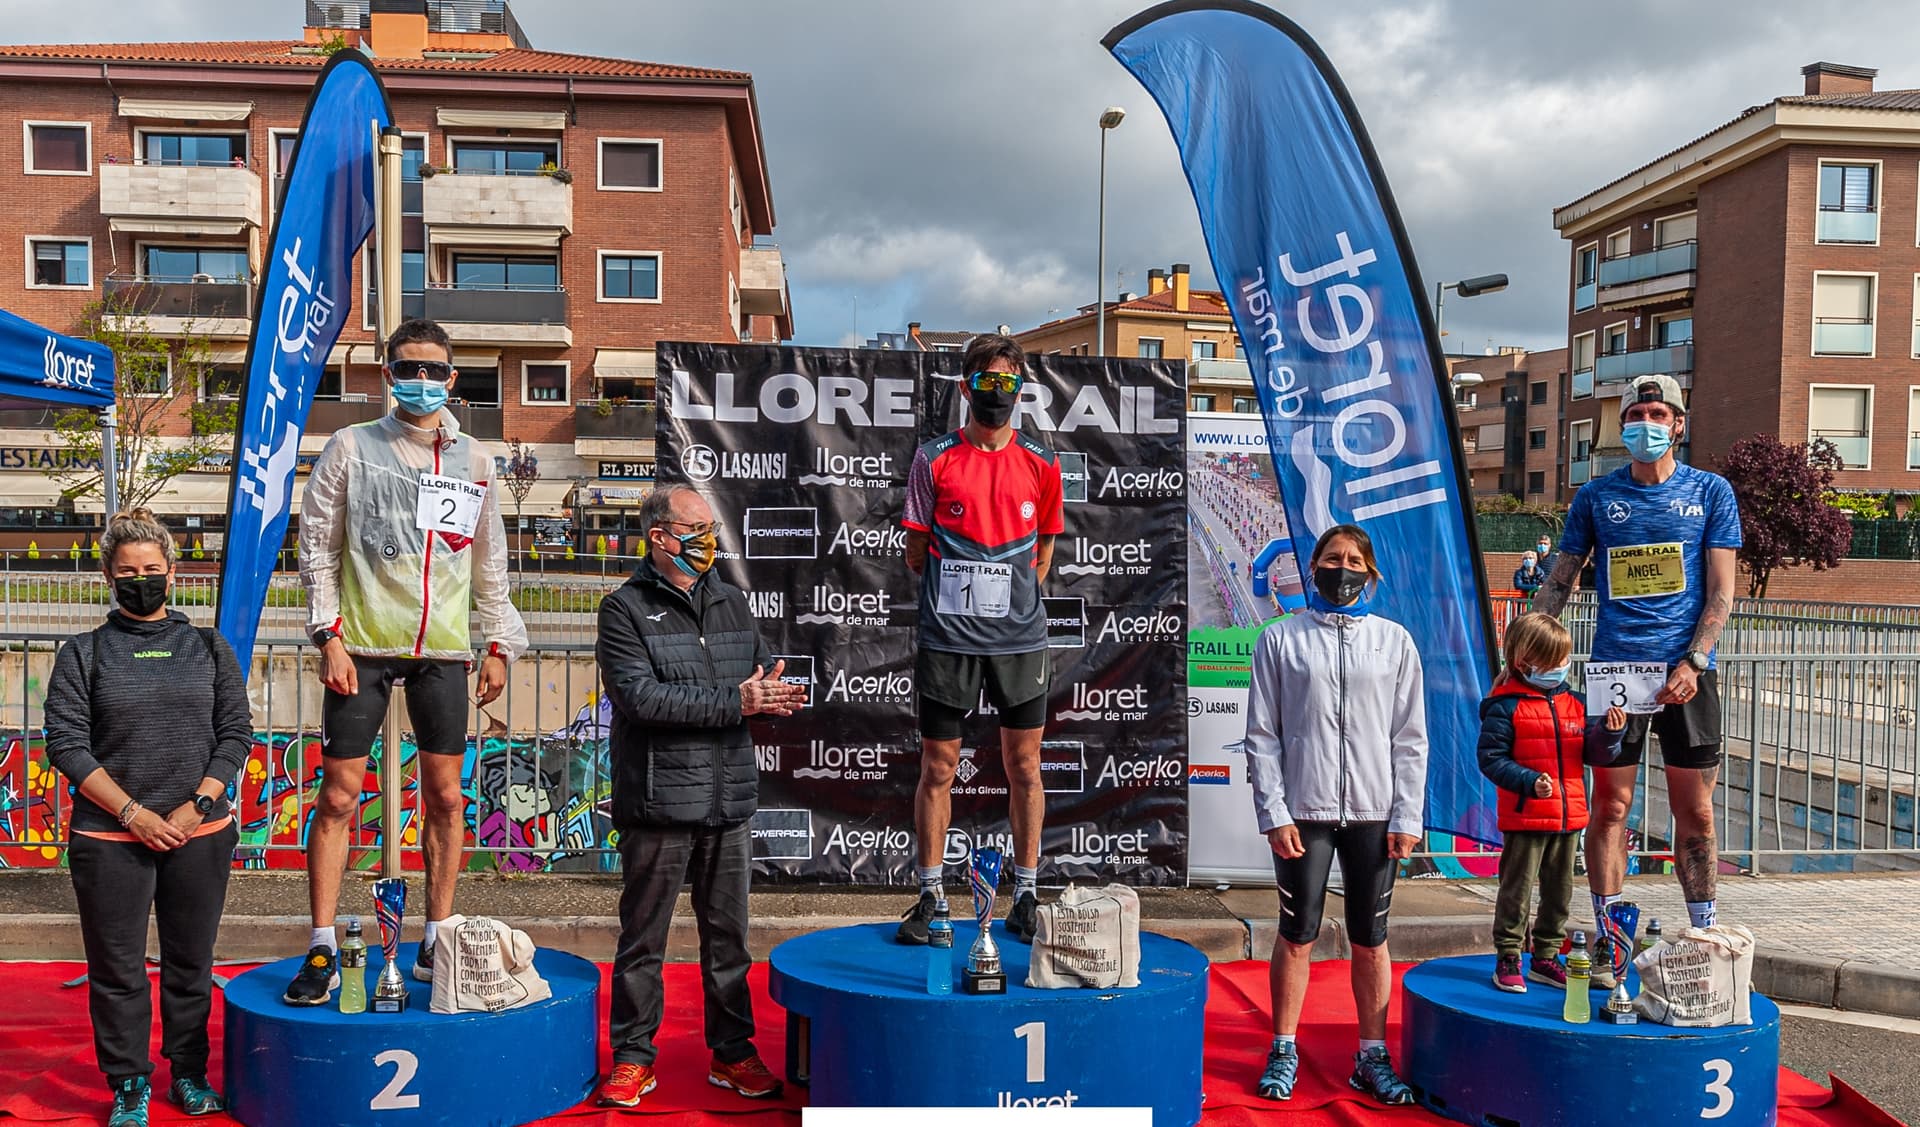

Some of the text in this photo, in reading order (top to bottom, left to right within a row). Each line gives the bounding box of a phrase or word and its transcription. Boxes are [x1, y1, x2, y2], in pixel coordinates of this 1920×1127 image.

[44, 335, 95, 388] lloret
[958, 372, 1178, 434] RAIL
[602, 464, 620, 476] EL
[722, 452, 787, 479] LASANSI
[816, 447, 892, 476] lloret
[849, 477, 892, 489] de mar
[1098, 466, 1184, 498] Acerko
[440, 498, 456, 525] 2
[749, 528, 814, 537] POWERADE
[853, 549, 902, 557] TELECO
[1075, 537, 1151, 563] lloret
[1108, 565, 1151, 575] de mar
[742, 590, 784, 618] ANSI
[814, 585, 890, 614] lloret
[961, 584, 970, 609] 1
[847, 615, 890, 626] de mar
[1046, 618, 1081, 626] ERADE
[1096, 610, 1181, 643] Acerko
[1187, 641, 1231, 656] TRAIL
[825, 669, 912, 702] Acerko
[1073, 682, 1148, 709] lloret
[1610, 682, 1627, 707] 3
[1105, 710, 1147, 721] de mar
[1206, 701, 1238, 714] LASANSI
[811, 740, 888, 767] lloret
[1041, 762, 1080, 770] ERADE
[844, 769, 887, 780] de mar
[1095, 755, 1181, 788] Acerko
[965, 786, 977, 794] de
[978, 786, 1008, 795] Girona
[751, 829, 808, 837] OWERADE
[822, 824, 910, 855] Acerko
[1072, 827, 1148, 853] lloret
[1105, 854, 1148, 864] de mar
[1057, 908, 1100, 919] ESTA BOLSA
[1057, 921, 1097, 933] SOSTENIBLE
[1666, 952, 1711, 968] ESTA BOLSA
[1668, 966, 1711, 982] SOSTENIBLE
[1014, 1021, 1045, 1083] 1
[370, 1049, 420, 1111] 2
[1701, 1059, 1735, 1119] 3
